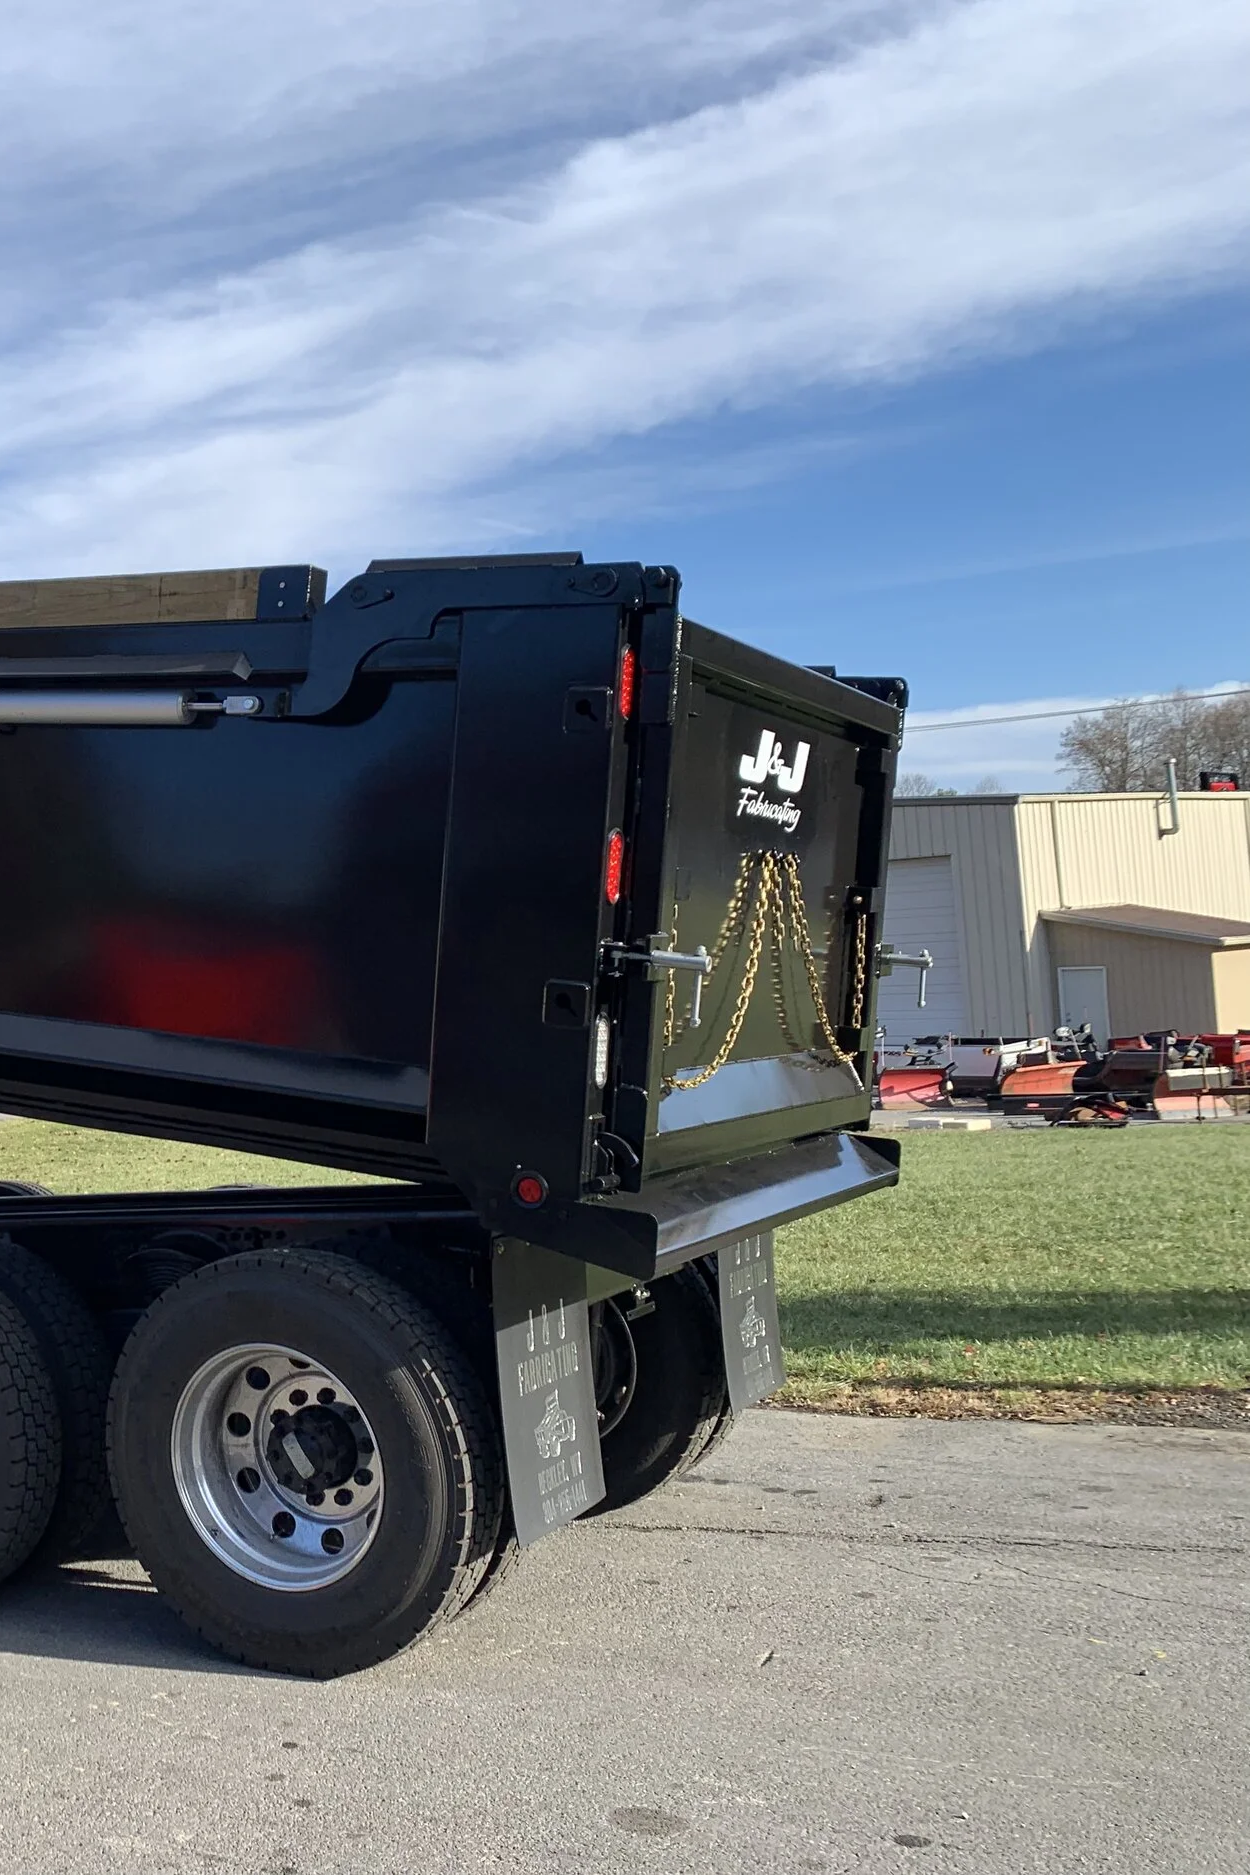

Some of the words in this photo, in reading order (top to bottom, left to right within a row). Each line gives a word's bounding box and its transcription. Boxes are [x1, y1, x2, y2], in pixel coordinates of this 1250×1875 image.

[739, 729, 810, 793] J&J
[736, 786, 801, 833] Fabricating
[526, 1309, 535, 1352] J
[541, 1304, 550, 1345] &
[557, 1298, 566, 1339] J
[517, 1341, 579, 1397] FABRICATING
